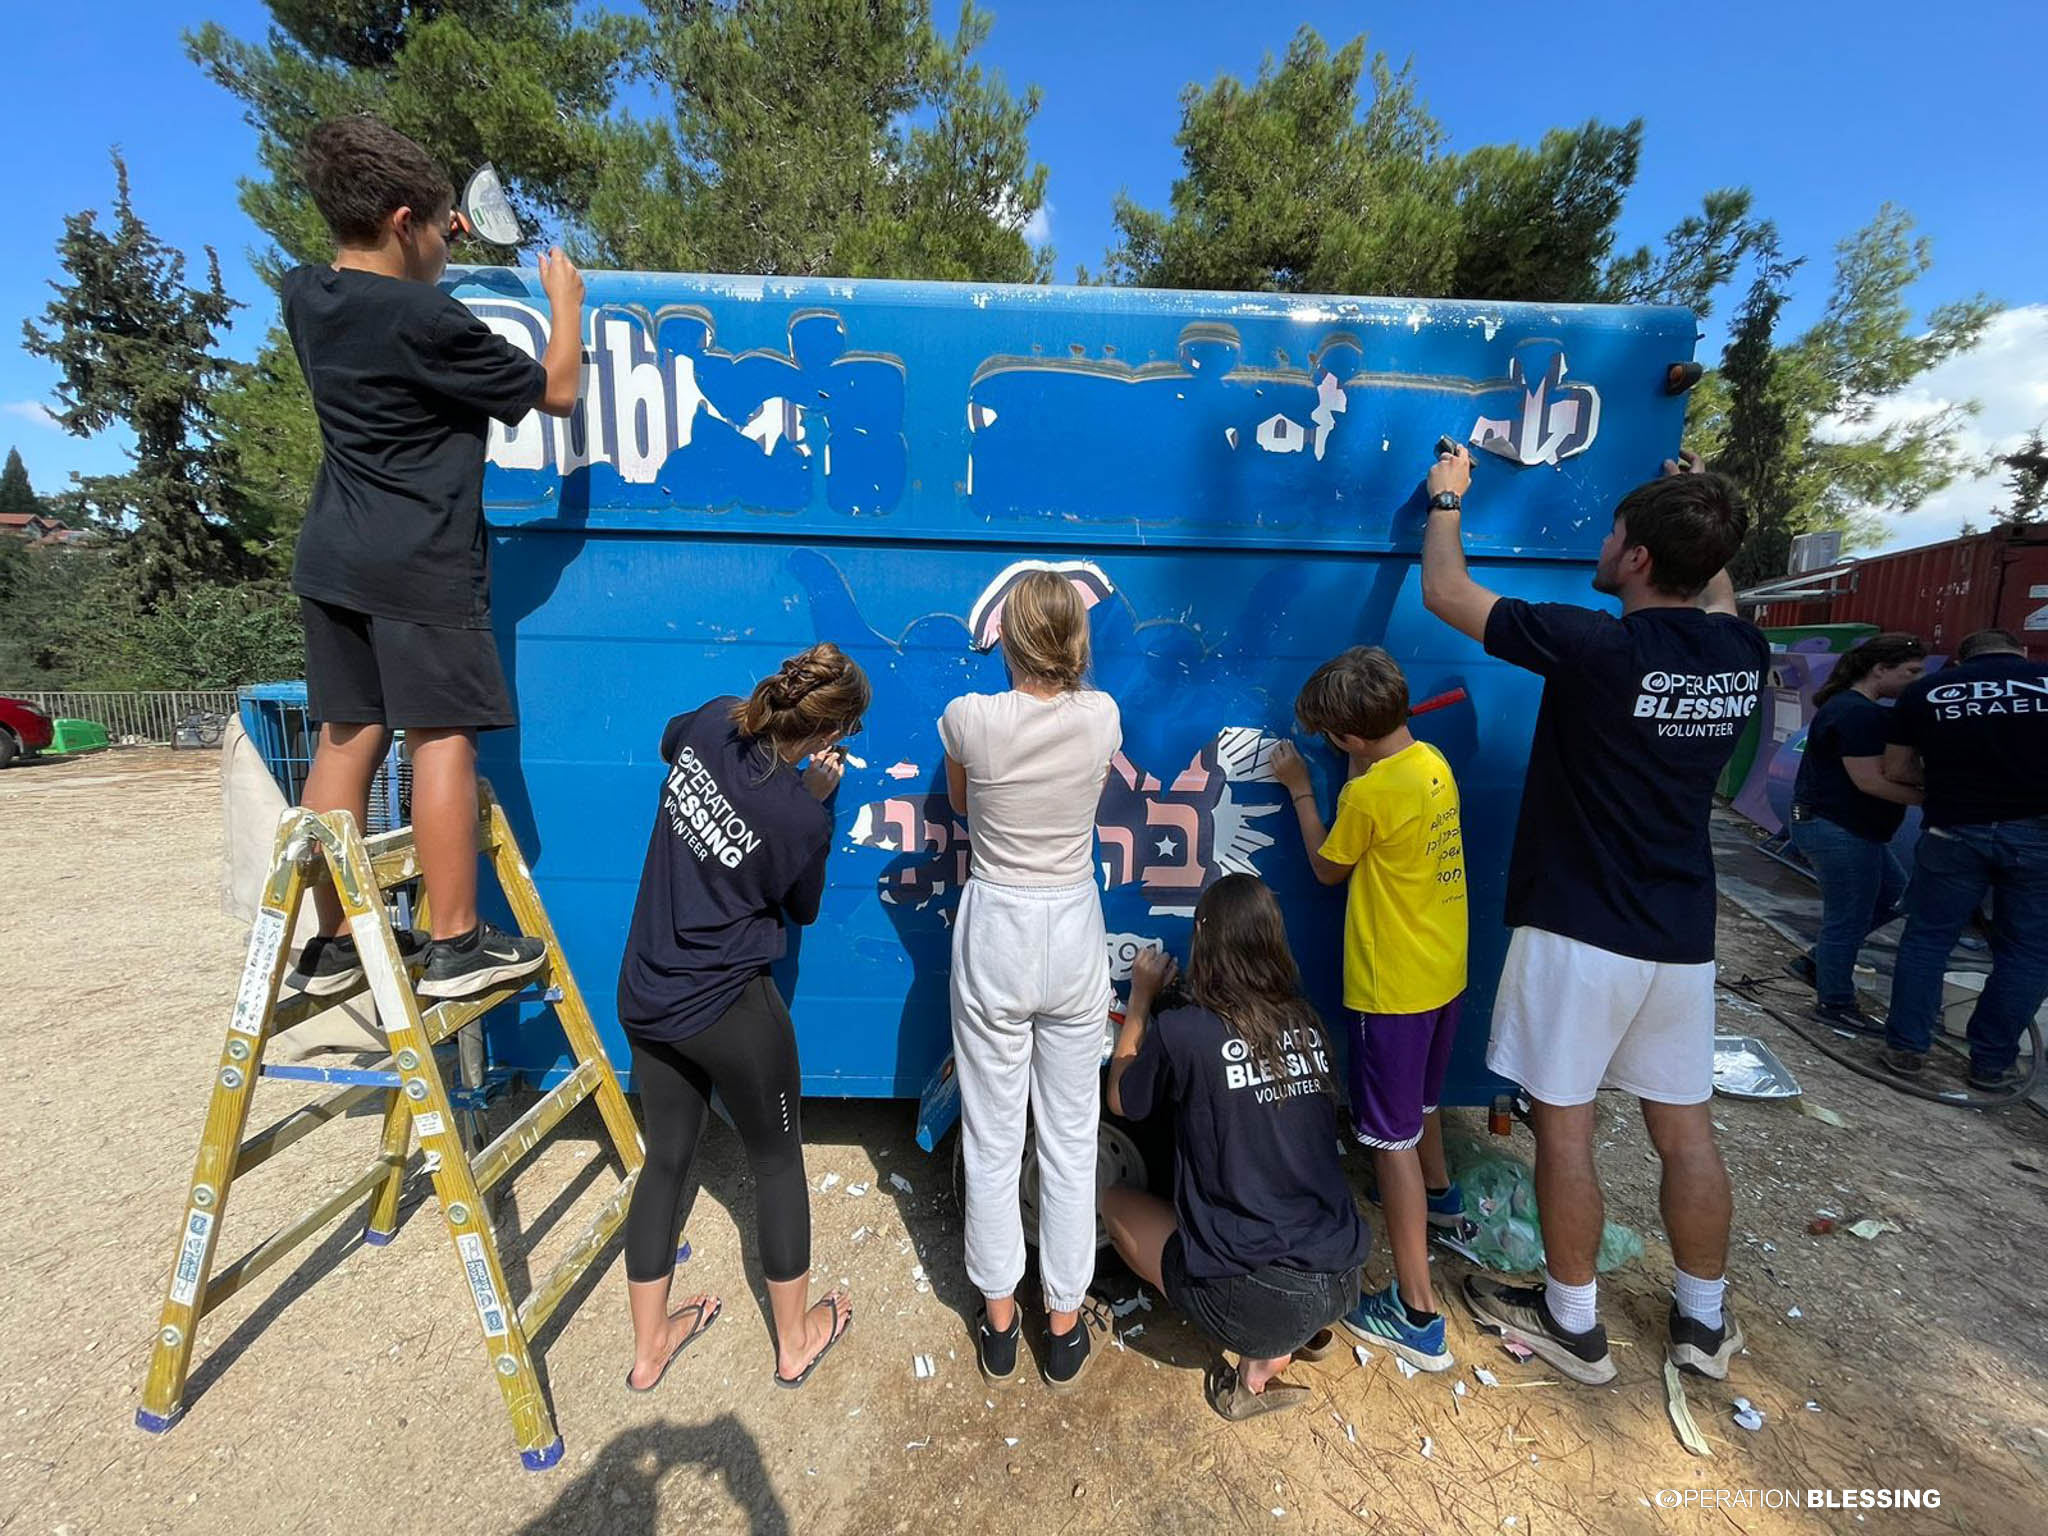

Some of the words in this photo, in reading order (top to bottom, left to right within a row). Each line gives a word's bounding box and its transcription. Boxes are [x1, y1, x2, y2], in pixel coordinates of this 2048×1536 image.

[1642, 671, 1759, 695] OPERATION
[1926, 677, 2048, 703] CBN
[1935, 698, 2048, 721] ISRAEL
[1658, 723, 1733, 737] VOLUNTEER
[678, 746, 762, 854] OPERATION
